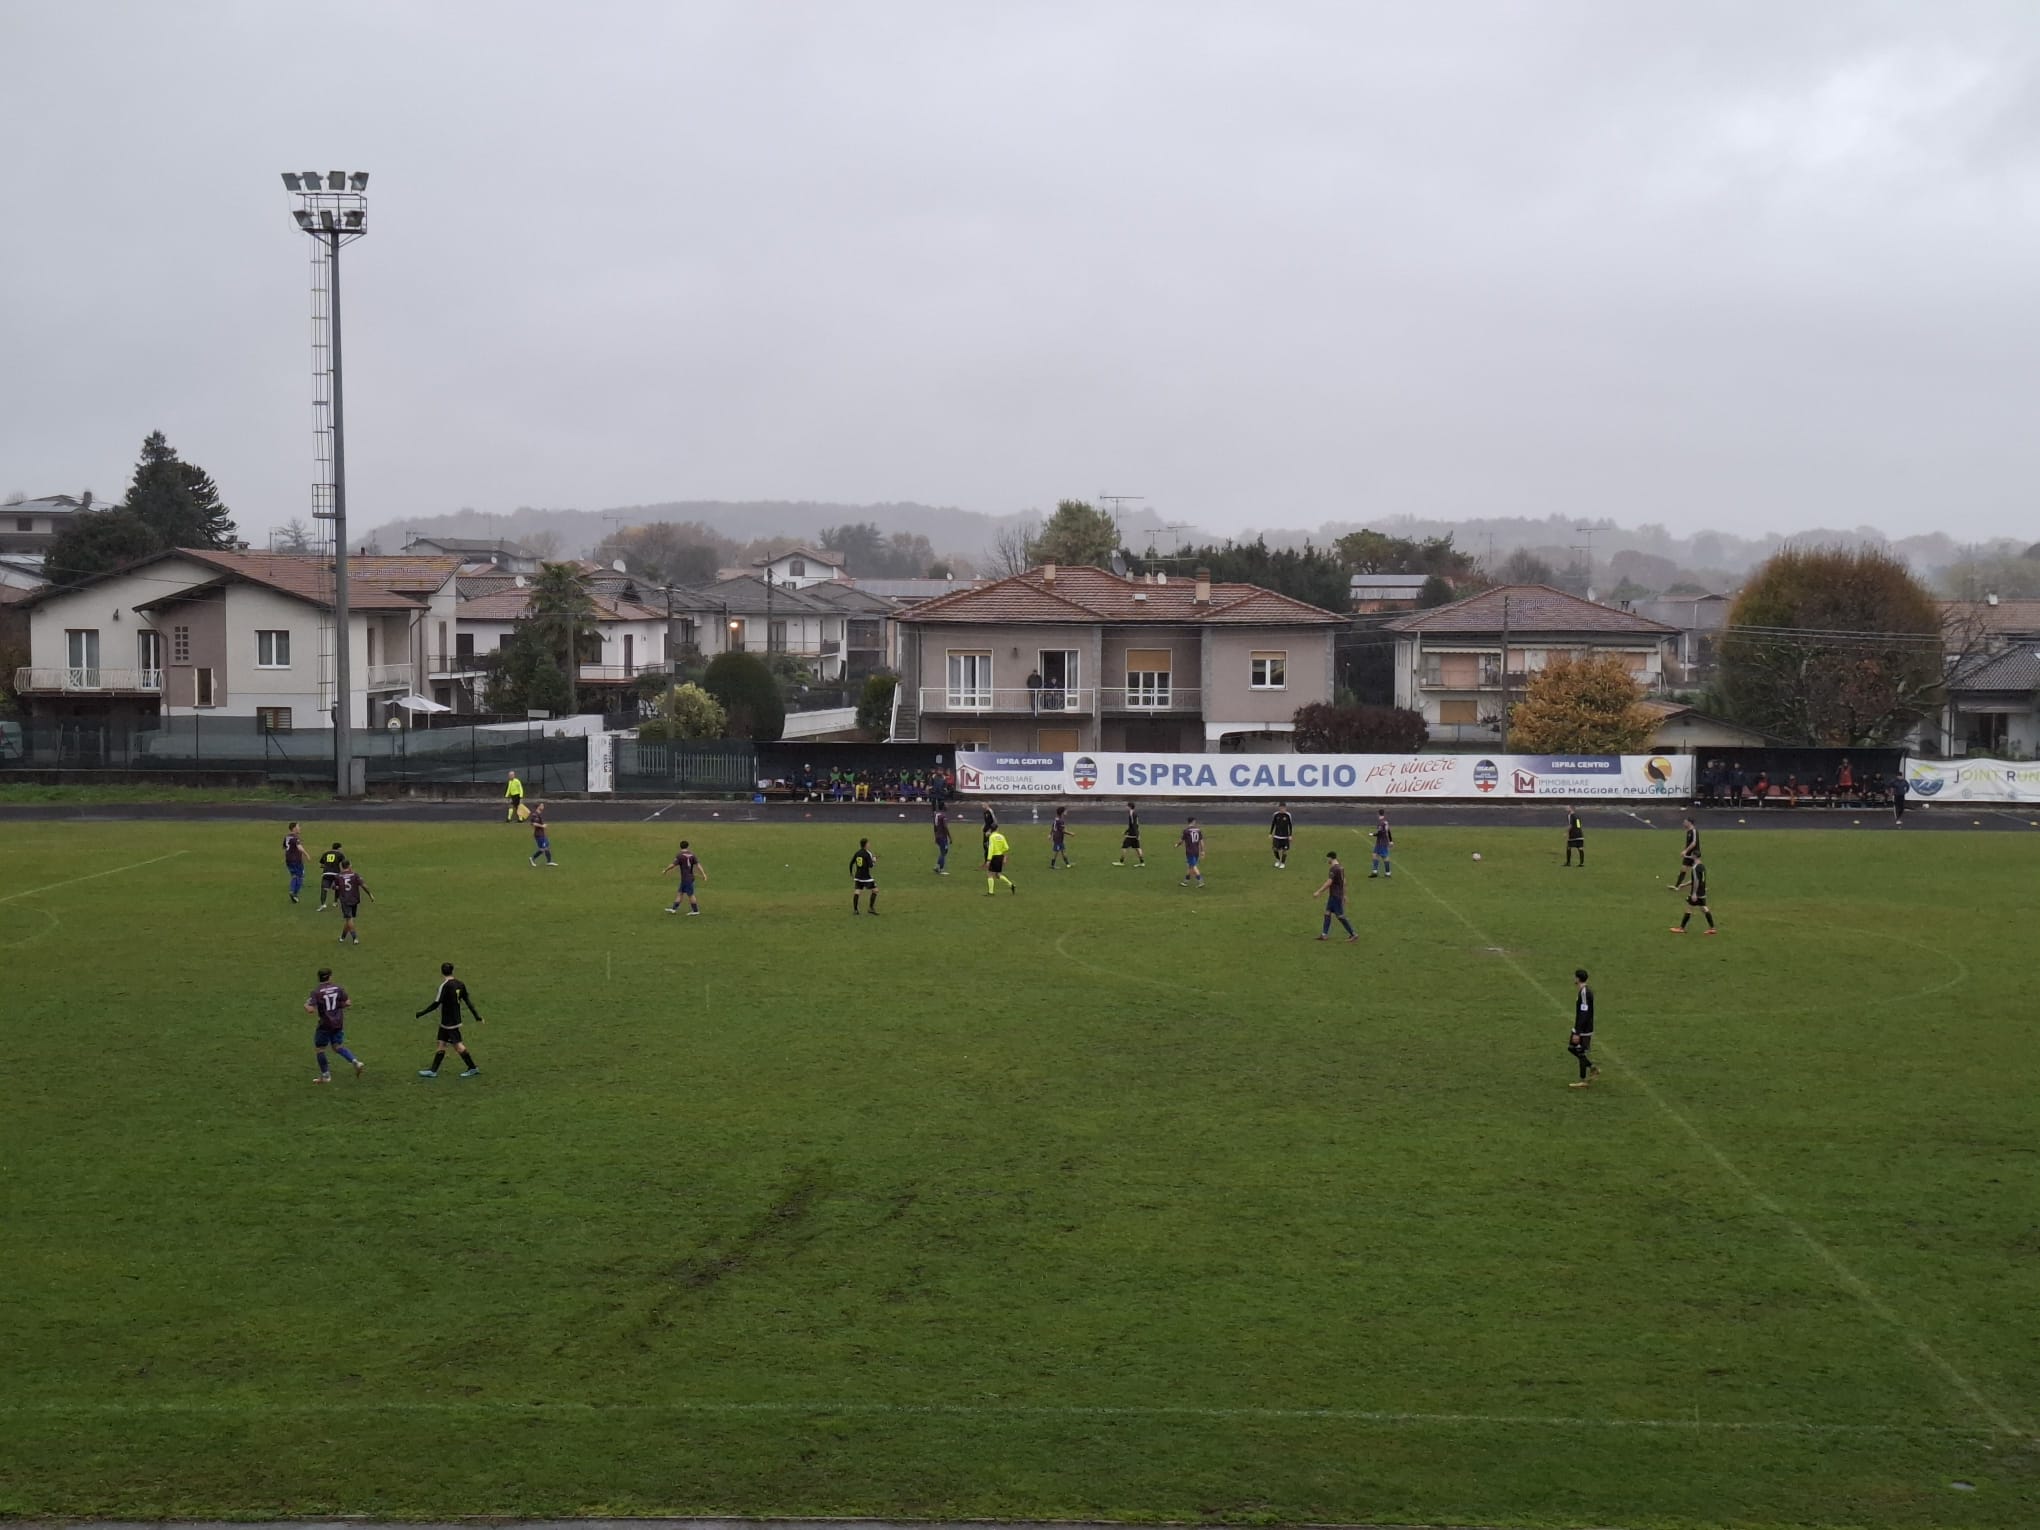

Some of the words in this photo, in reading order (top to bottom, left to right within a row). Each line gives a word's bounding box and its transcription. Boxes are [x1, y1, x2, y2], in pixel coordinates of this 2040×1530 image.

[1116, 763, 1217, 786] ISPRA
[1229, 764, 1357, 787] CALCIO
[1365, 763, 1395, 782] per
[1400, 758, 1456, 774] vincere
[1385, 776, 1443, 794] insieme
[1623, 785, 1690, 795] newGraphic
[1191, 831, 1199, 842] 10
[344, 879, 352, 891] 5
[323, 993, 338, 1011] 17
